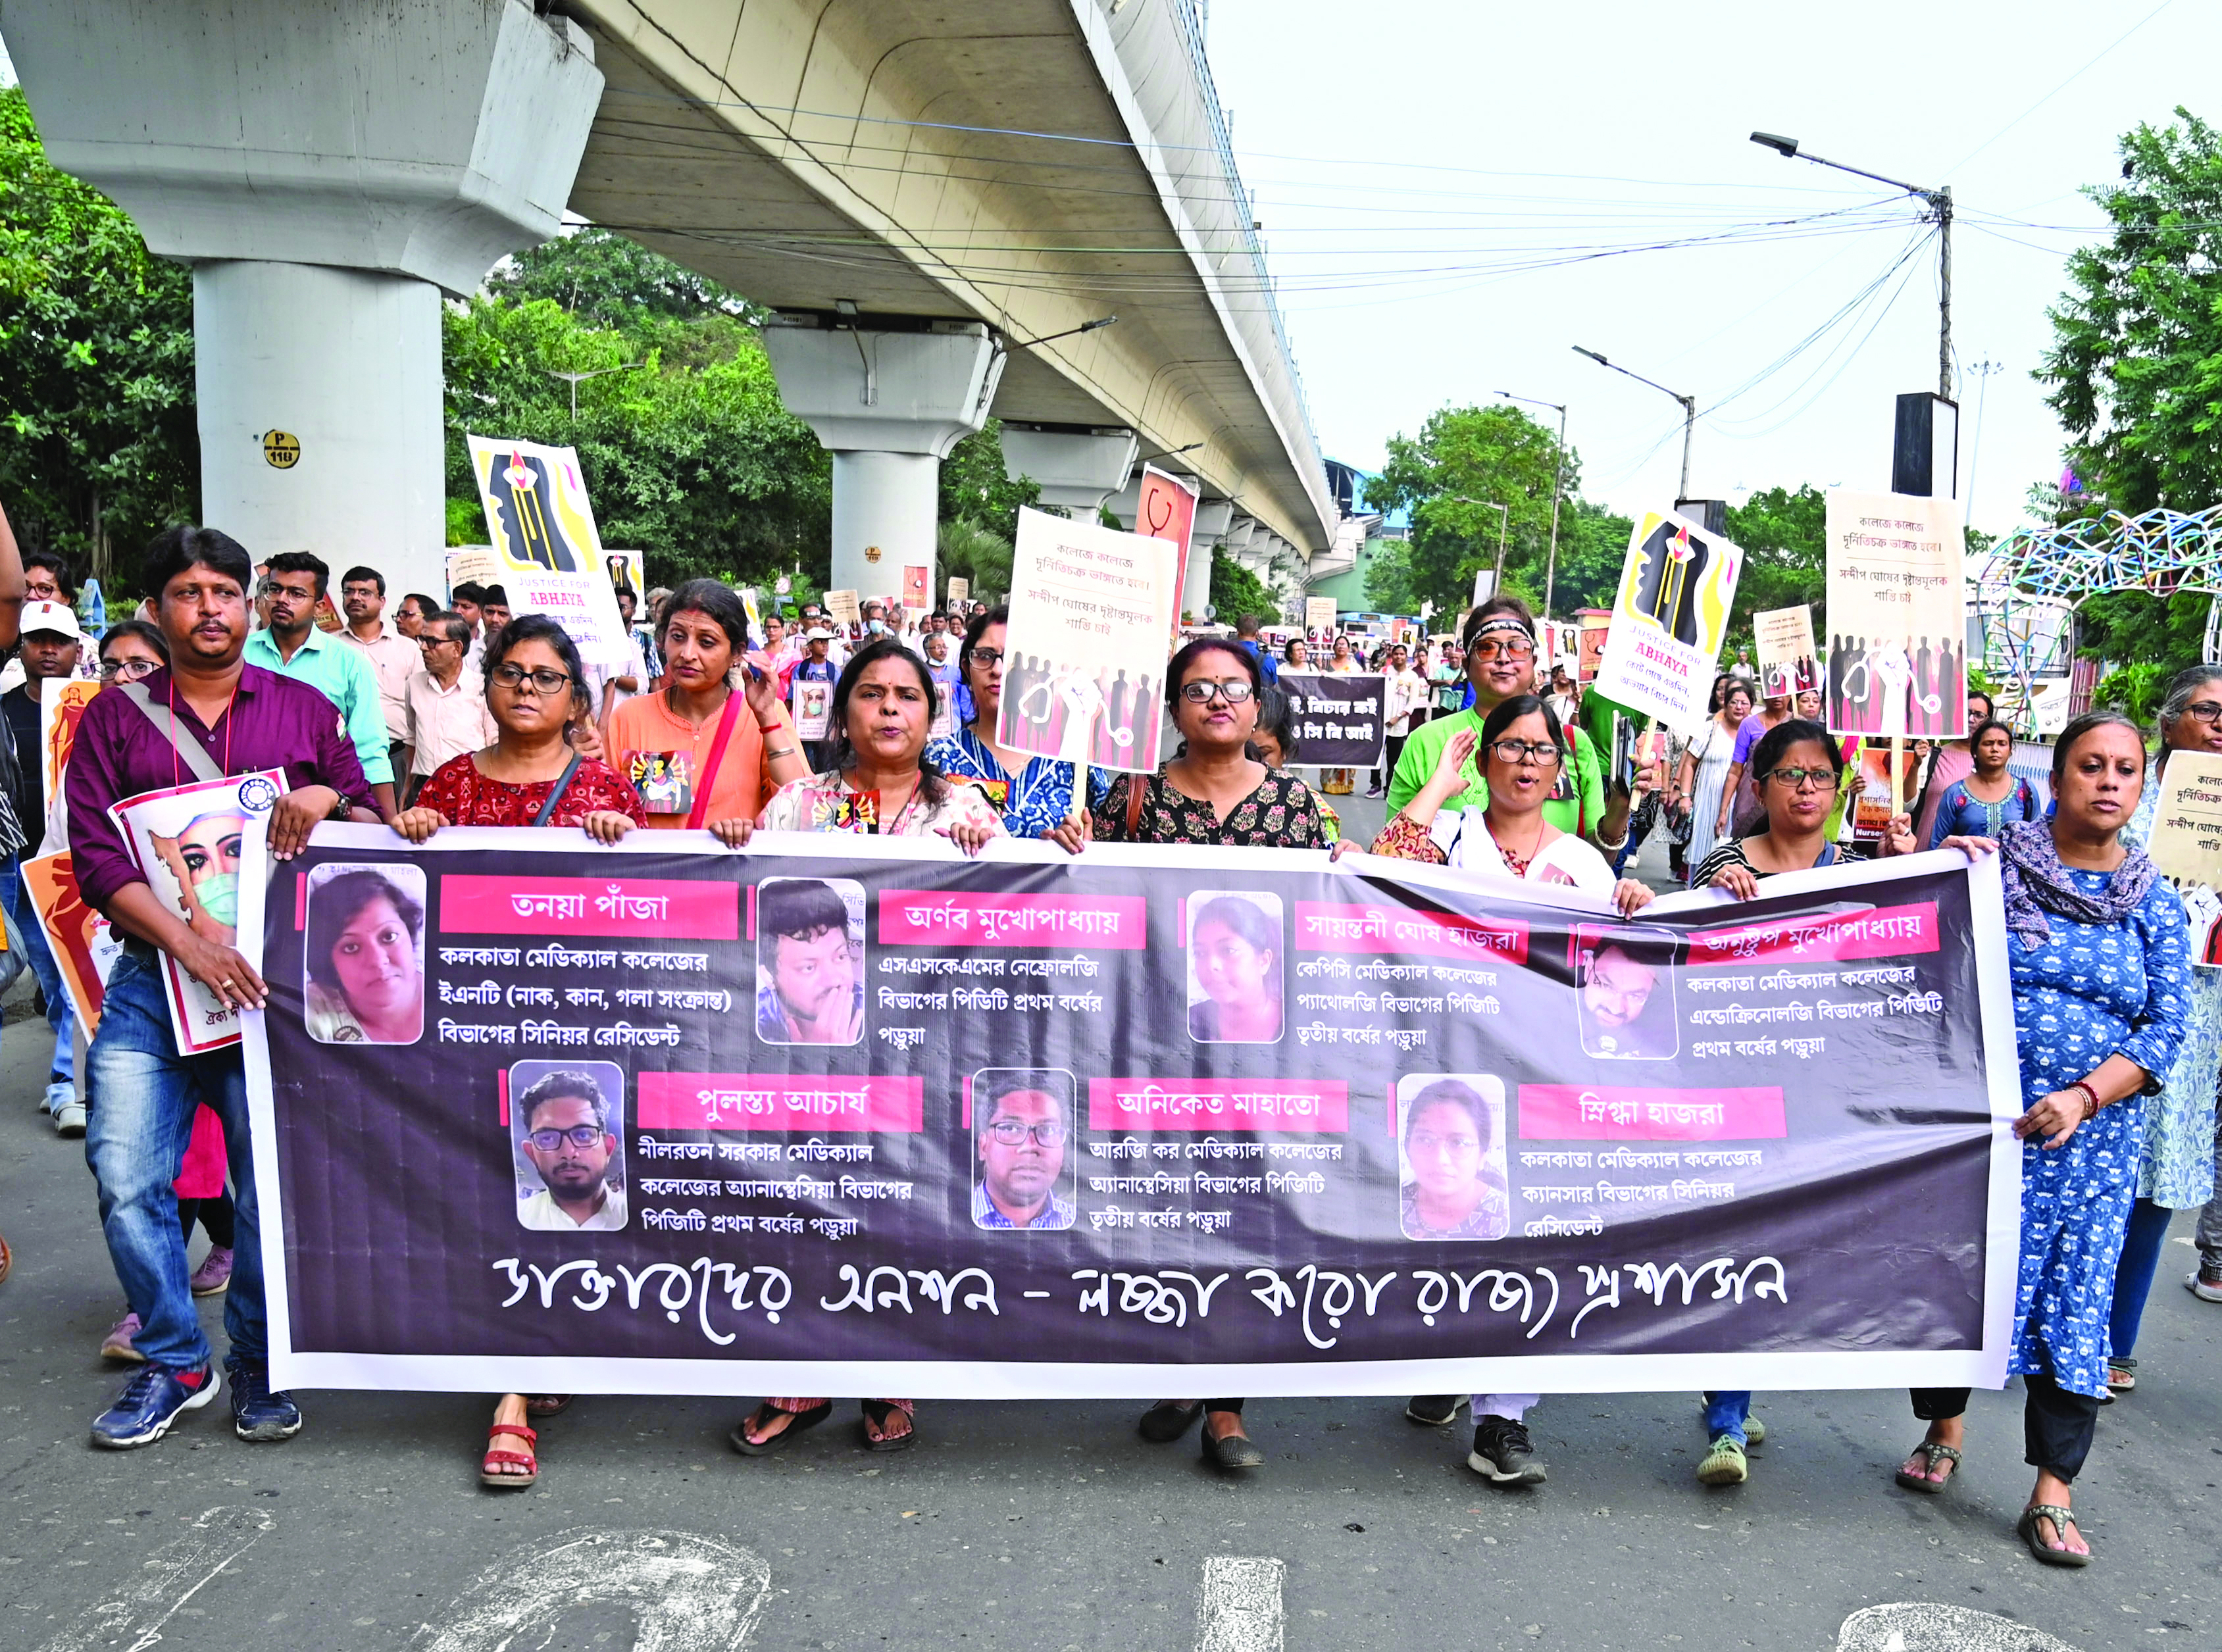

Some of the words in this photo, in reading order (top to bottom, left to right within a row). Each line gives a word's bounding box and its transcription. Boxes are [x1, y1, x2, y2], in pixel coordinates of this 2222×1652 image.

[275, 433, 284, 445] P
[270, 451, 292, 462] 118
[1859, 517, 1892, 528] কলেজে
[1895, 520, 1924, 532] কলেজে
[1057, 544, 1094, 560] কলেজে
[1098, 552, 1134, 568] কলেজে
[1890, 539, 1917, 550] ভাঙ্গতে
[1921, 543, 1941, 552] হবে।
[519, 577, 566, 587] JUSTICE
[1090, 570, 1123, 585] ভাঙ্গতে
[1128, 578, 1149, 590] হবে।
[1840, 566, 1866, 580] সন্দীপ
[1870, 572, 1900, 583] ঘোষের
[530, 592, 586, 606] ABHAYA
[1028, 589, 1059, 605] সন্দীপ
[1063, 599, 1096, 613] ঘোষের
[1875, 589, 1896, 602] শাস্তি
[1900, 591, 1911, 604] চাই
[1066, 618, 1090, 630] শাস্তি
[1095, 622, 1111, 636] চাই
[1630, 626, 1676, 653] JUSTICE
[1680, 651, 1701, 665] FOR
[1634, 641, 1688, 677] ABHAYA
[1627, 661, 1644, 672] কেটে
[1646, 668, 1662, 681] গেছে
[1664, 678, 1689, 698] এতদিন,
[1307, 695, 1351, 716] বিচার
[1353, 697, 1377, 716] কই
[1621, 676, 1649, 694] অভয়ার
[1651, 687, 1668, 704] বিচার
[1671, 697, 1687, 713] দিন।
[1304, 722, 1323, 739] সি
[1345, 723, 1373, 741] আই
[2166, 817, 2195, 830] সন্দীপ
[2197, 839, 2220, 851] শাস্তি
[511, 892, 586, 920] তনয়া
[594, 884, 670, 921] পাঁজা
[904, 899, 970, 932] অর্ণব
[977, 906, 1121, 940] মুখোপাধ্যায়
[1305, 911, 1387, 940] সায়ন্তনী
[1395, 922, 1440, 943] ঘোষ
[1448, 927, 1519, 951] হাজরা
[1790, 914, 1921, 955] মুখোপাধ্যায়
[440, 947, 521, 967] কলকাতা
[526, 943, 616, 970] মেডিক্যাল
[622, 951, 708, 972] কলেজের
[878, 957, 1004, 977] এসএসকেএমের
[1010, 955, 1099, 978] নেফ্রোলজি
[1297, 957, 1350, 980] কেপিসি
[1355, 960, 1428, 983] মেডিক্যাল
[1433, 966, 1497, 987] কলেজের
[1687, 974, 1754, 994] কলকাতা
[1760, 970, 1837, 991] মেডিক্যাল
[1841, 965, 1915, 987] কলেজের
[439, 980, 501, 1005] ইএনটি
[507, 984, 559, 1009] (নাক,
[565, 988, 609, 1011] কান,
[617, 989, 652, 1009] গলা
[659, 990, 732, 1014] সংক্রান্ত)
[878, 988, 948, 1011] বিভাগের
[1013, 992, 1053, 1013] প্রথম
[1059, 988, 1102, 1013] বর্ষের
[1298, 991, 1376, 1014] প্যাথোলজি
[1381, 993, 1444, 1014] বিভাগের
[1448, 993, 1500, 1016] পিজিটি
[1690, 1003, 1814, 1026] এন্ডোক্রিনোলজি
[1818, 997, 1884, 1020] বিভাগের
[439, 1018, 516, 1045] বিভাগের
[522, 1020, 588, 1046] সিনিয়র
[594, 1022, 681, 1048] রেসিডেন্ট
[878, 1025, 925, 1051] পড়ুয়া
[1297, 1022, 1338, 1047] তৃতীয়
[1342, 1024, 1380, 1045] বর্ষের
[1386, 1028, 1427, 1051] পড়ুয়া
[1692, 1040, 1731, 1059] প্রথম
[1735, 1035, 1776, 1057] বর্ষের
[1780, 1036, 1825, 1059] পড়ুয়া
[696, 1088, 776, 1124] পুলস্ত্য
[784, 1084, 869, 1116] আচার্য
[1117, 1084, 1225, 1115] অনিকেত
[1233, 1091, 1320, 1116] মাহাতো
[1579, 1091, 1638, 1124] স্নিগ্ধা
[1647, 1101, 1725, 1126] হাজরা
[639, 1137, 713, 1161] নীলরতন
[719, 1143, 781, 1161] সরকার
[787, 1137, 874, 1163] মেডিক্যাল
[1090, 1137, 1148, 1160] আরজি
[1153, 1141, 1180, 1160] কর
[1185, 1136, 1264, 1160] মেডিক্যাল
[1269, 1141, 1342, 1161] কলেজের
[1520, 1151, 1593, 1169] কলকাতা
[1597, 1147, 1679, 1170] মেডিক্যাল
[1683, 1149, 1762, 1168] কলেজের
[640, 1178, 720, 1199] কলেজের
[726, 1174, 835, 1201] অ্যানাস্থেসিয়া
[840, 1175, 913, 1199] বিভাগের
[1090, 1171, 1189, 1194] অ্যানাস্থেসিয়া
[1195, 1171, 1261, 1194] বিভাগের
[1266, 1172, 1325, 1193] পিজিটি
[1521, 1183, 1593, 1204] ক্যানসার
[1598, 1180, 1669, 1204] বিভাগের
[1673, 1180, 1735, 1201] সিনিয়র
[642, 1209, 707, 1232] পিজিটি
[711, 1214, 753, 1234] প্রথম
[759, 1211, 804, 1235] বর্ষের
[809, 1214, 858, 1241] পড়ুয়া
[1090, 1205, 1134, 1232] তৃতীয়
[1138, 1207, 1181, 1229] বর্ষের
[1186, 1210, 1231, 1235] পড়ুয়া
[1524, 1216, 1604, 1239] রেসিডেন্ট
[492, 1255, 792, 1346] ডাক্তারদের
[820, 1264, 999, 1316] অনশন
[1071, 1270, 1229, 1328] লজ্জা
[1245, 1264, 1398, 1349] করো
[1411, 1266, 1559, 1339] রাজ্য
